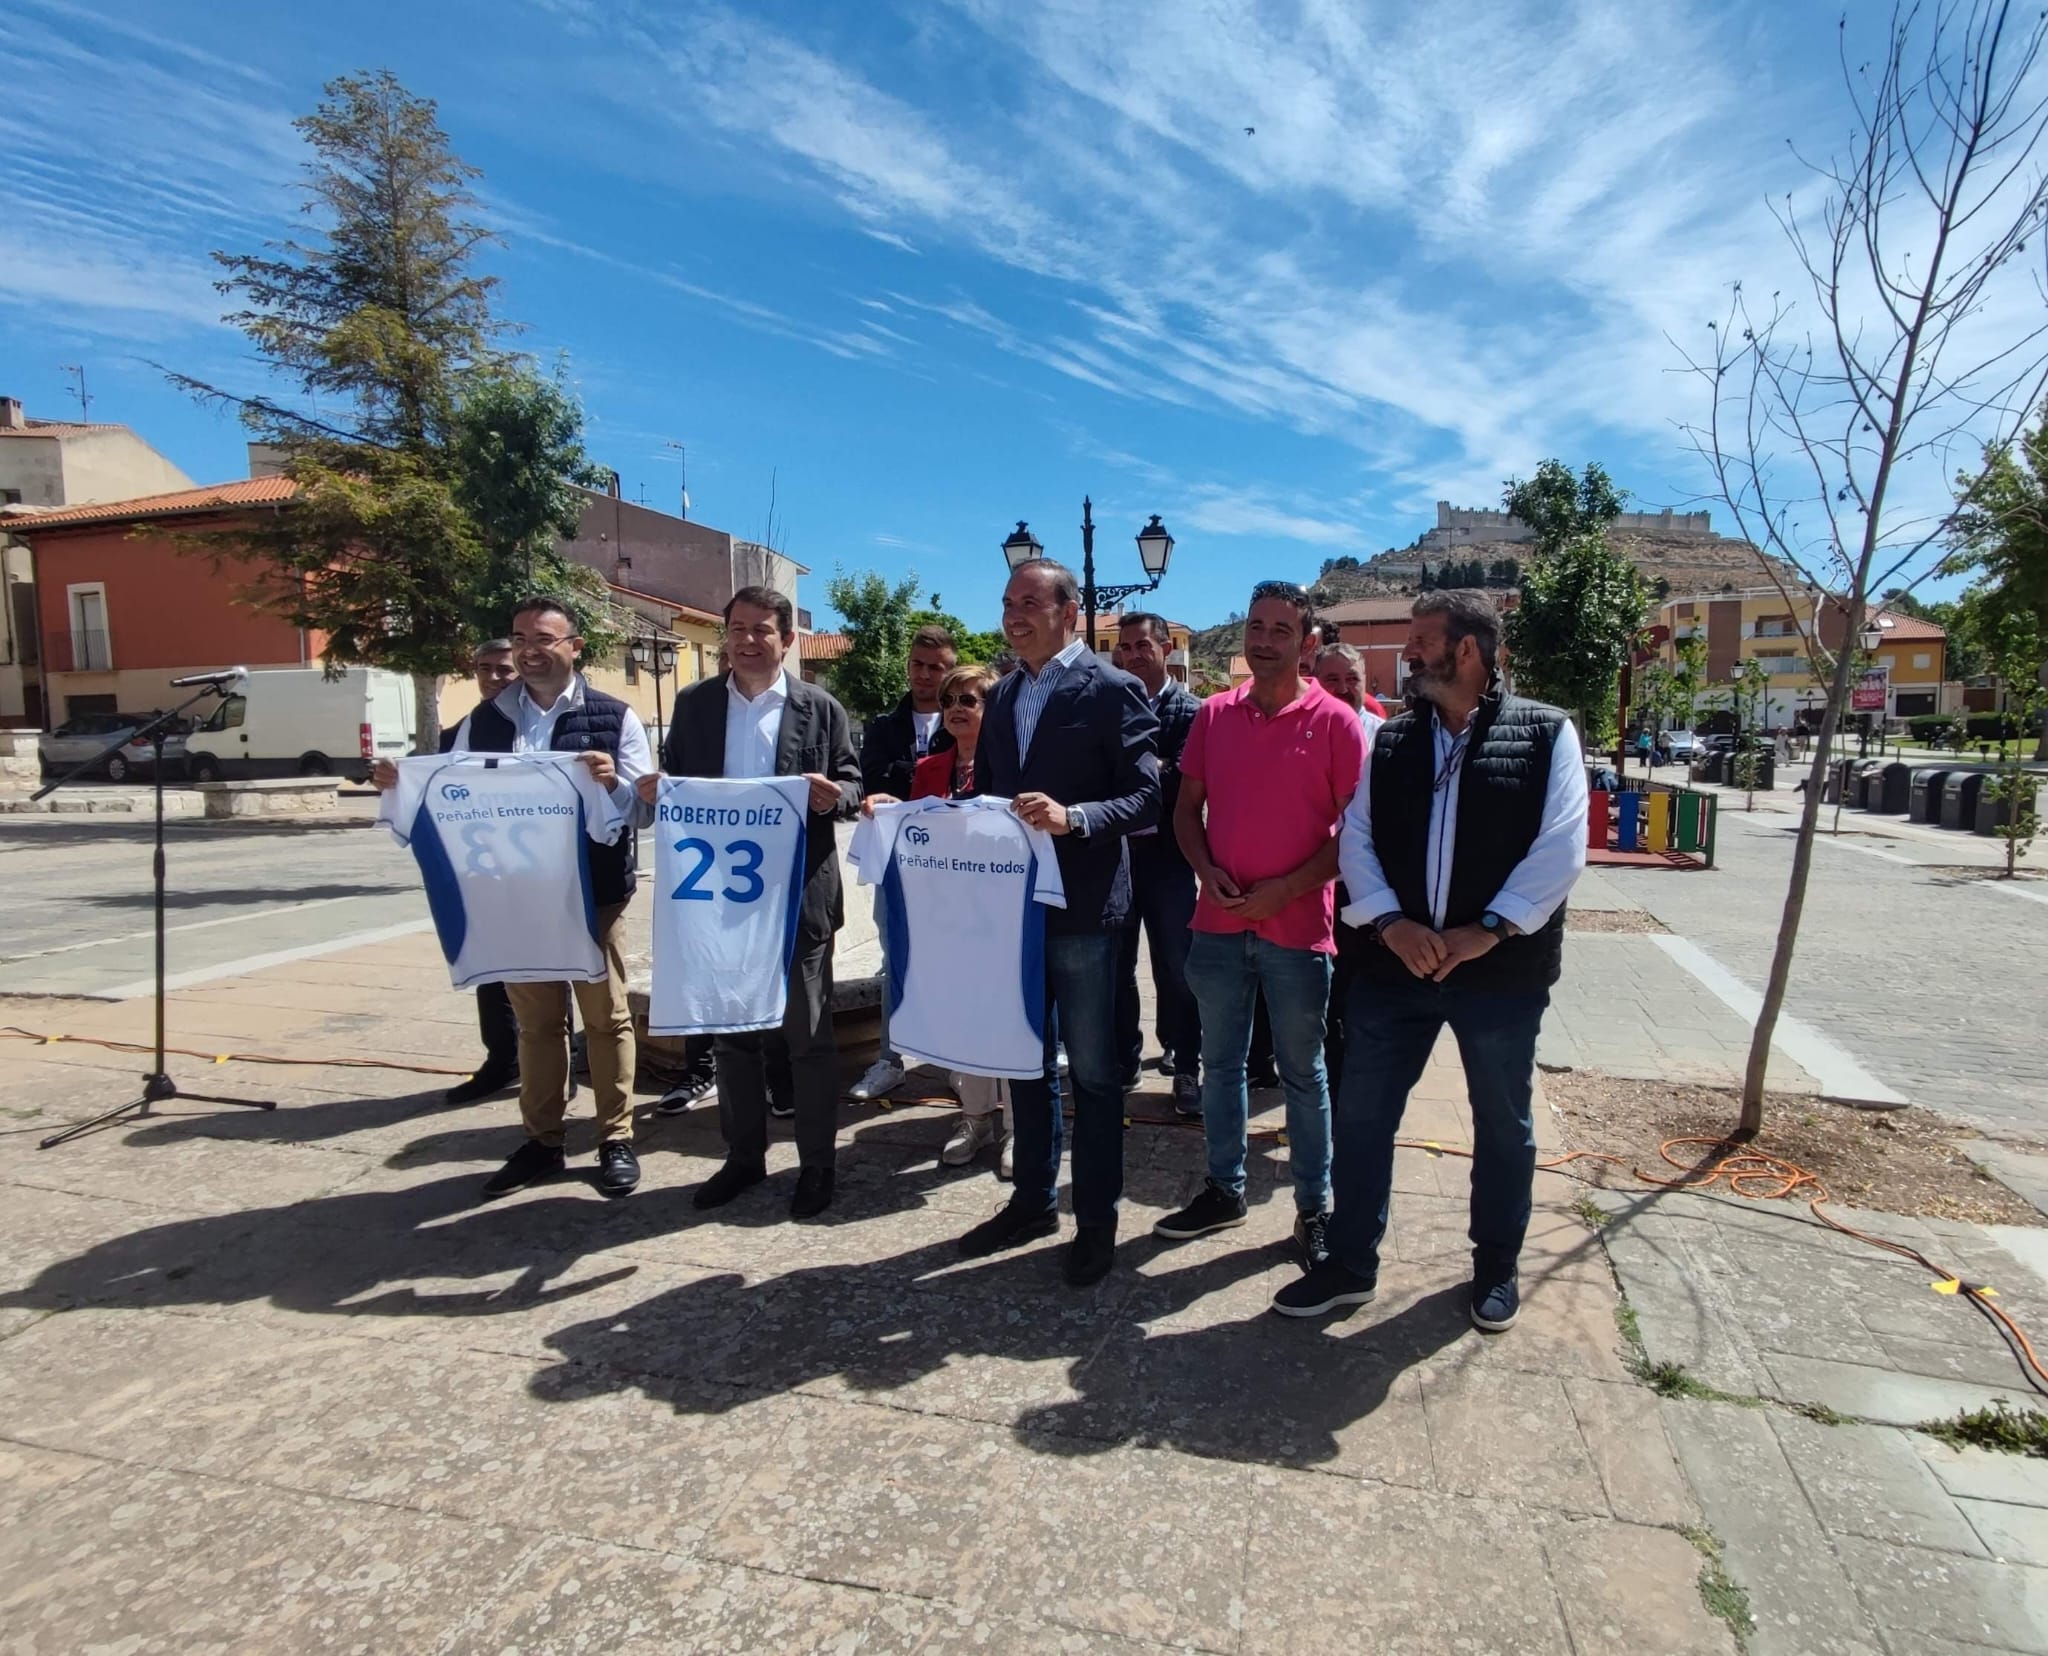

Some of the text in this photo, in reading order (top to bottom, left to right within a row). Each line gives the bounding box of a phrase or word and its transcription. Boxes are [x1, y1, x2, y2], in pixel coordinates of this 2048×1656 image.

[436, 803, 575, 823] Peñafiel Entre todos
[659, 803, 784, 827] ROBERTO DÍEZ
[671, 837, 765, 903] 23
[899, 853, 1025, 875] Peñafiel Entre todos
